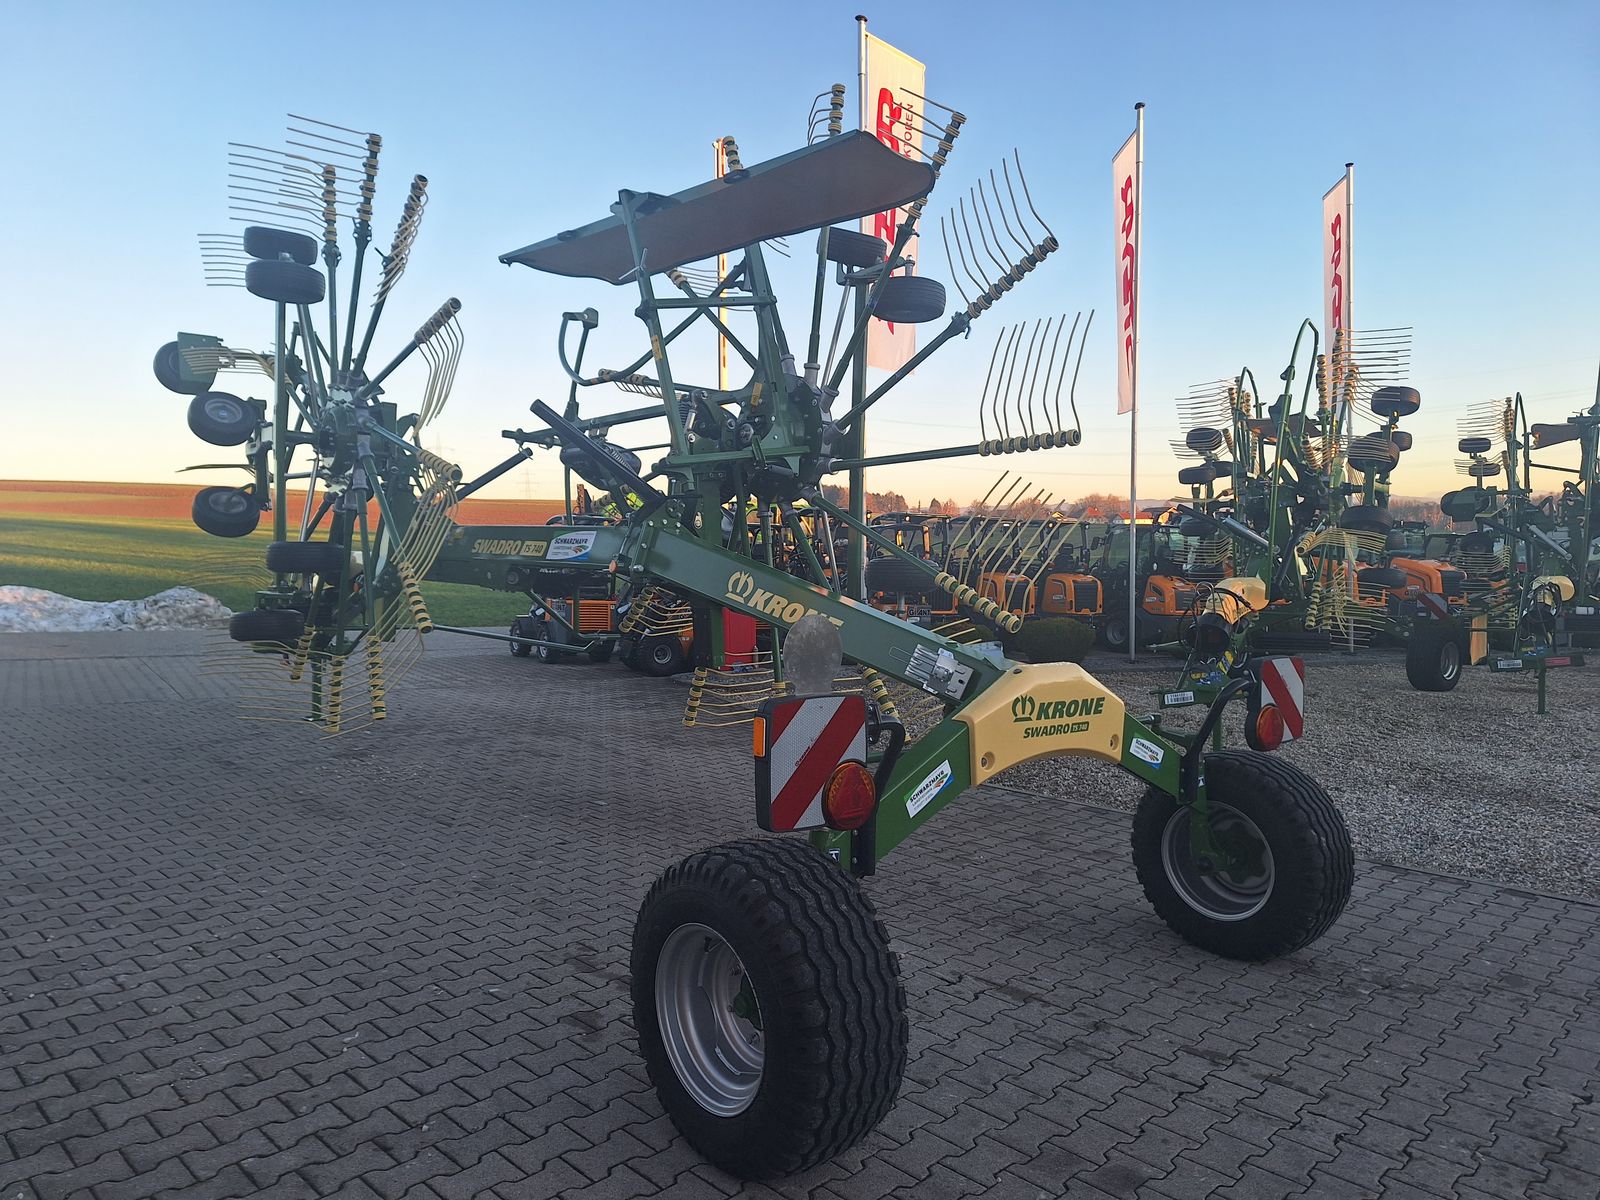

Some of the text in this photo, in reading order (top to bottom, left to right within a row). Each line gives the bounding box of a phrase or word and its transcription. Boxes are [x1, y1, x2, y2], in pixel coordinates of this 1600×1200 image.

[903, 103, 913, 158] KTOREN
[472, 539, 522, 555] SWADRO
[747, 588, 845, 630] KRO
[1036, 697, 1105, 720] KRONE
[1023, 723, 1070, 739] SWADRO
[910, 770, 945, 803] SCHWARZMAYR
